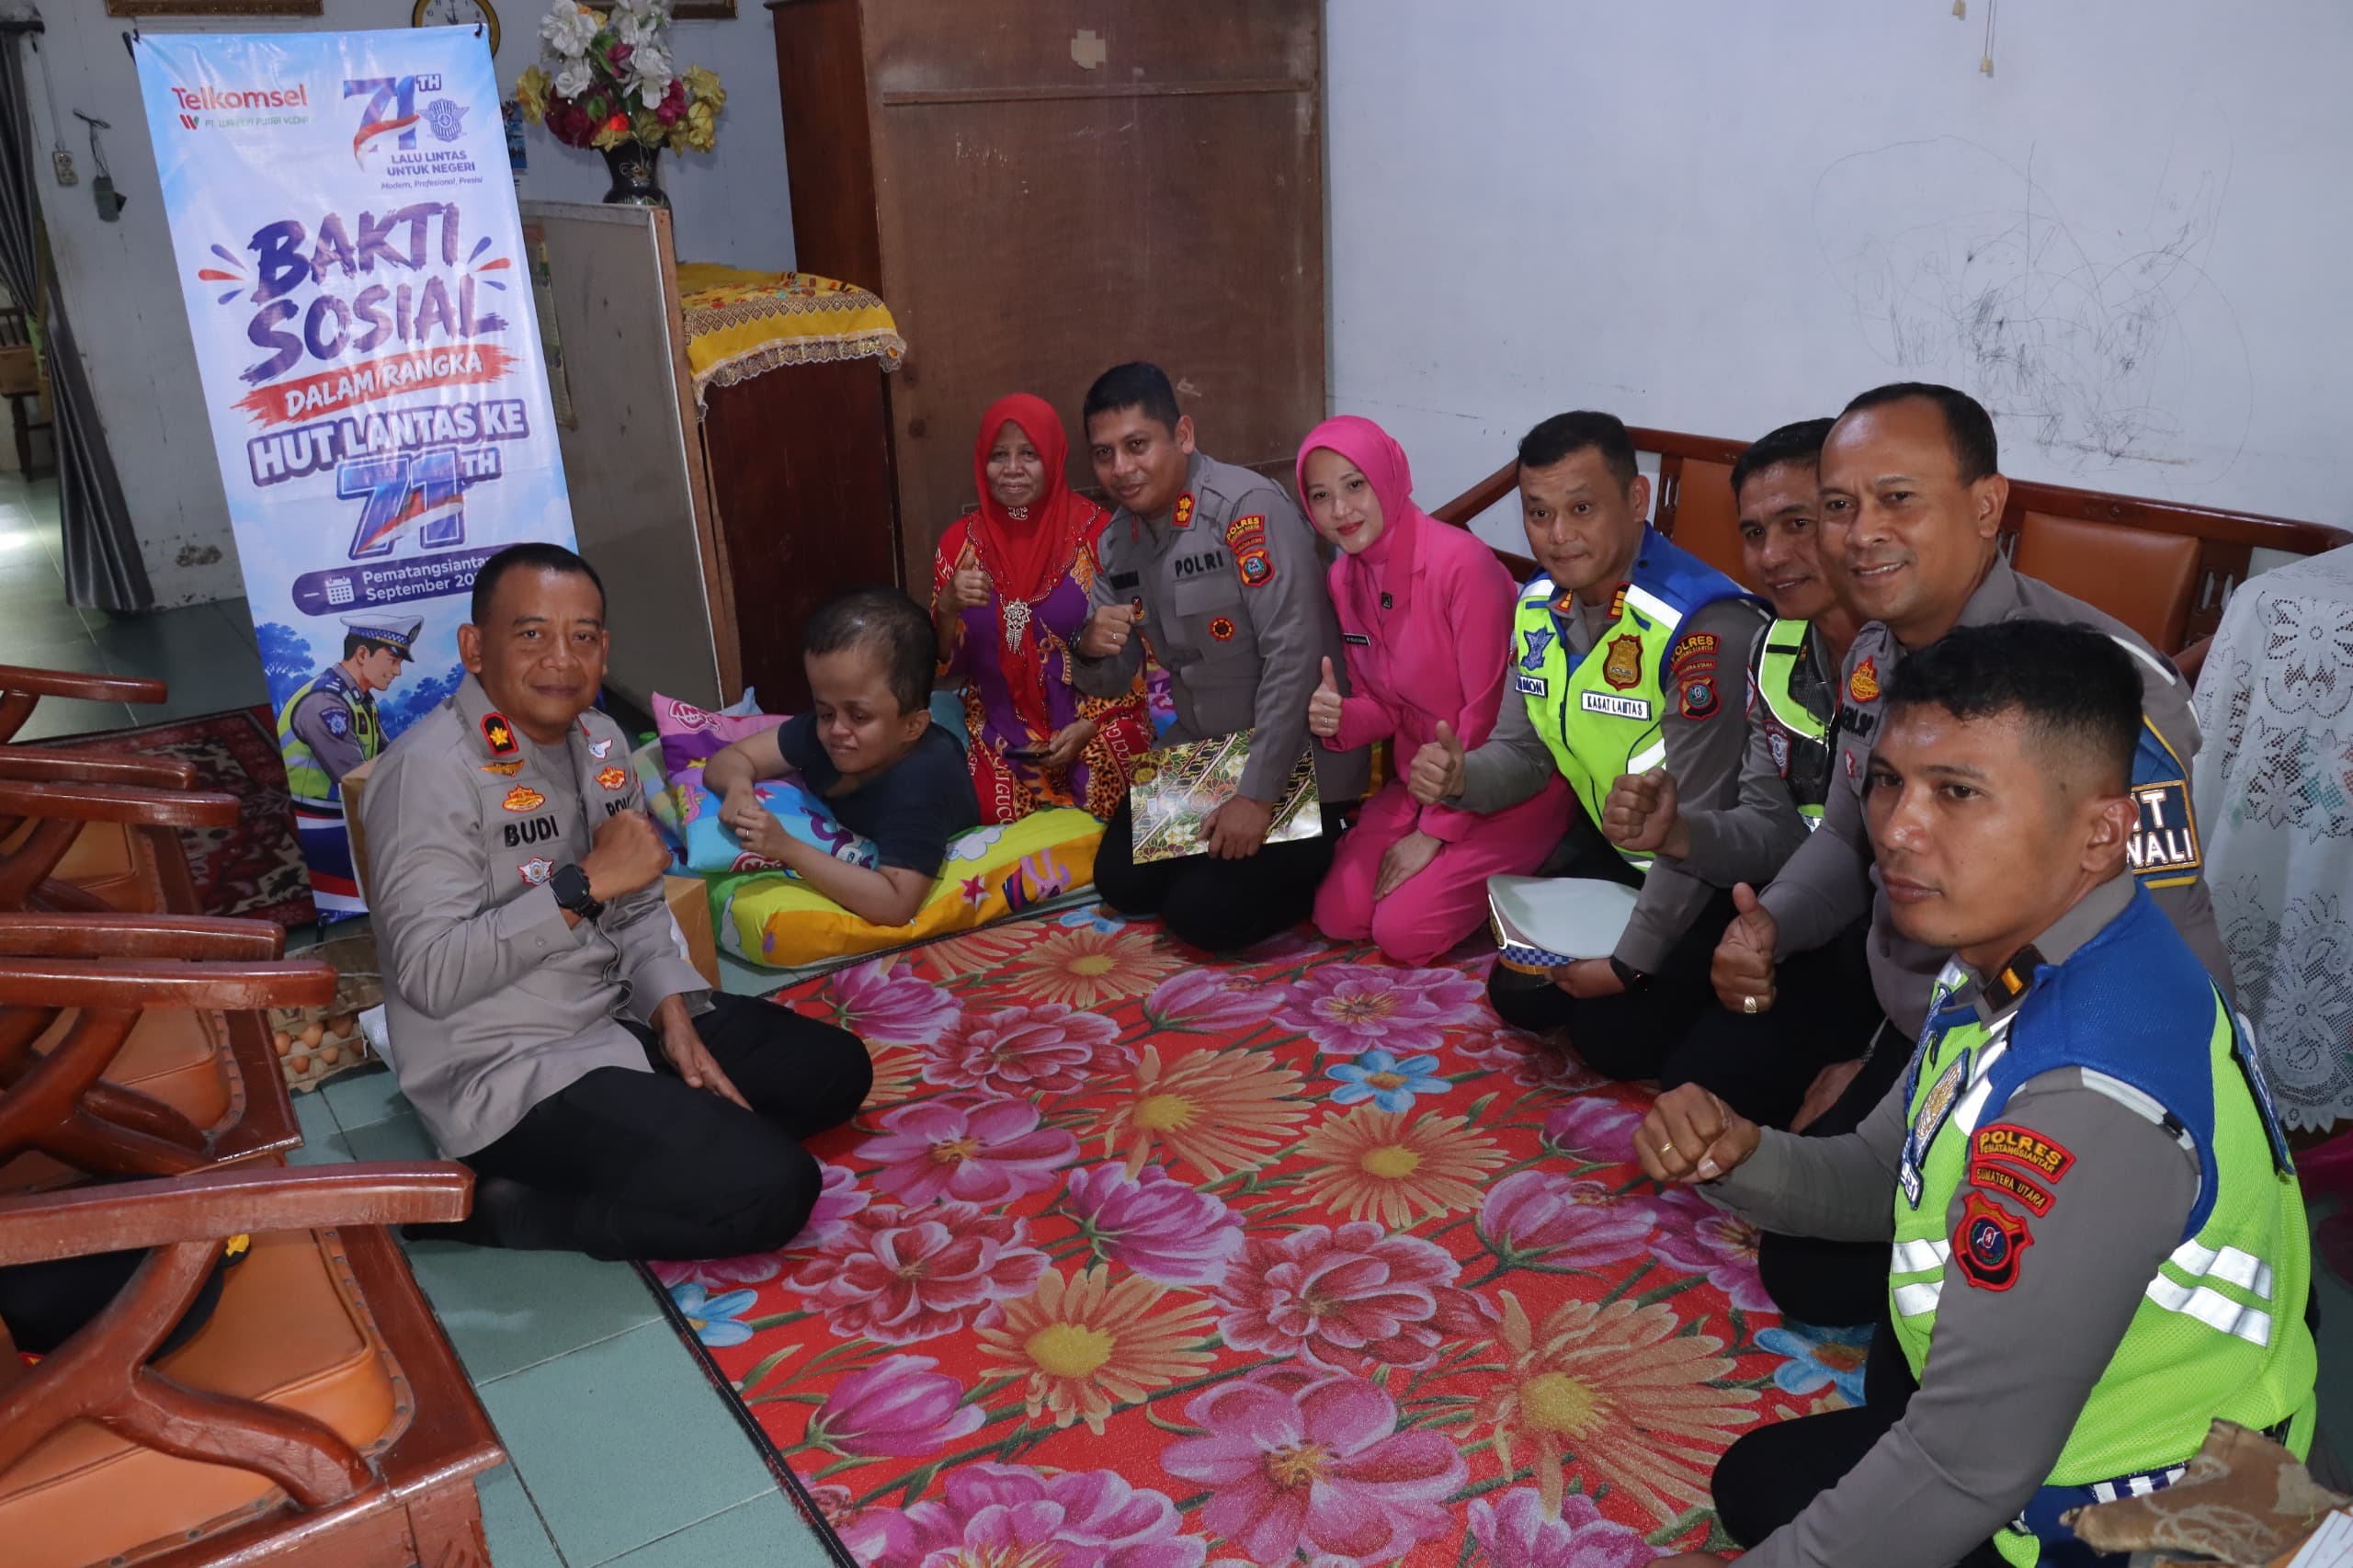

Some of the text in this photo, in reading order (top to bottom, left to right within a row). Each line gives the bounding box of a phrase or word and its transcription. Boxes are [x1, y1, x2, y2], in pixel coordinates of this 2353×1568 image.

[171, 83, 308, 110] Telkomsel
[416, 74, 441, 92] TH
[387, 162, 475, 176] UNTUK NEGERI
[391, 150, 467, 165] LALU LINTAS
[459, 176, 483, 184] Presisi
[247, 201, 460, 306] BAKTI
[239, 273, 509, 386] SOSIAL
[285, 350, 483, 417] DALAM RANGKA
[248, 398, 531, 486] HUT LANTAS KE
[460, 446, 502, 481] TH
[335, 446, 467, 561] 71
[1226, 517, 1260, 540] POLRES
[1175, 551, 1224, 578] POLRI
[366, 572, 478, 601] September 20
[1587, 695, 1643, 717] KASAT LANTAS
[995, 783, 1015, 825] GUCC
[505, 814, 559, 847] BUDI
[1979, 1131, 2063, 1165] POLRES
[1976, 1168, 2045, 1208] SUMATERA UTARA
